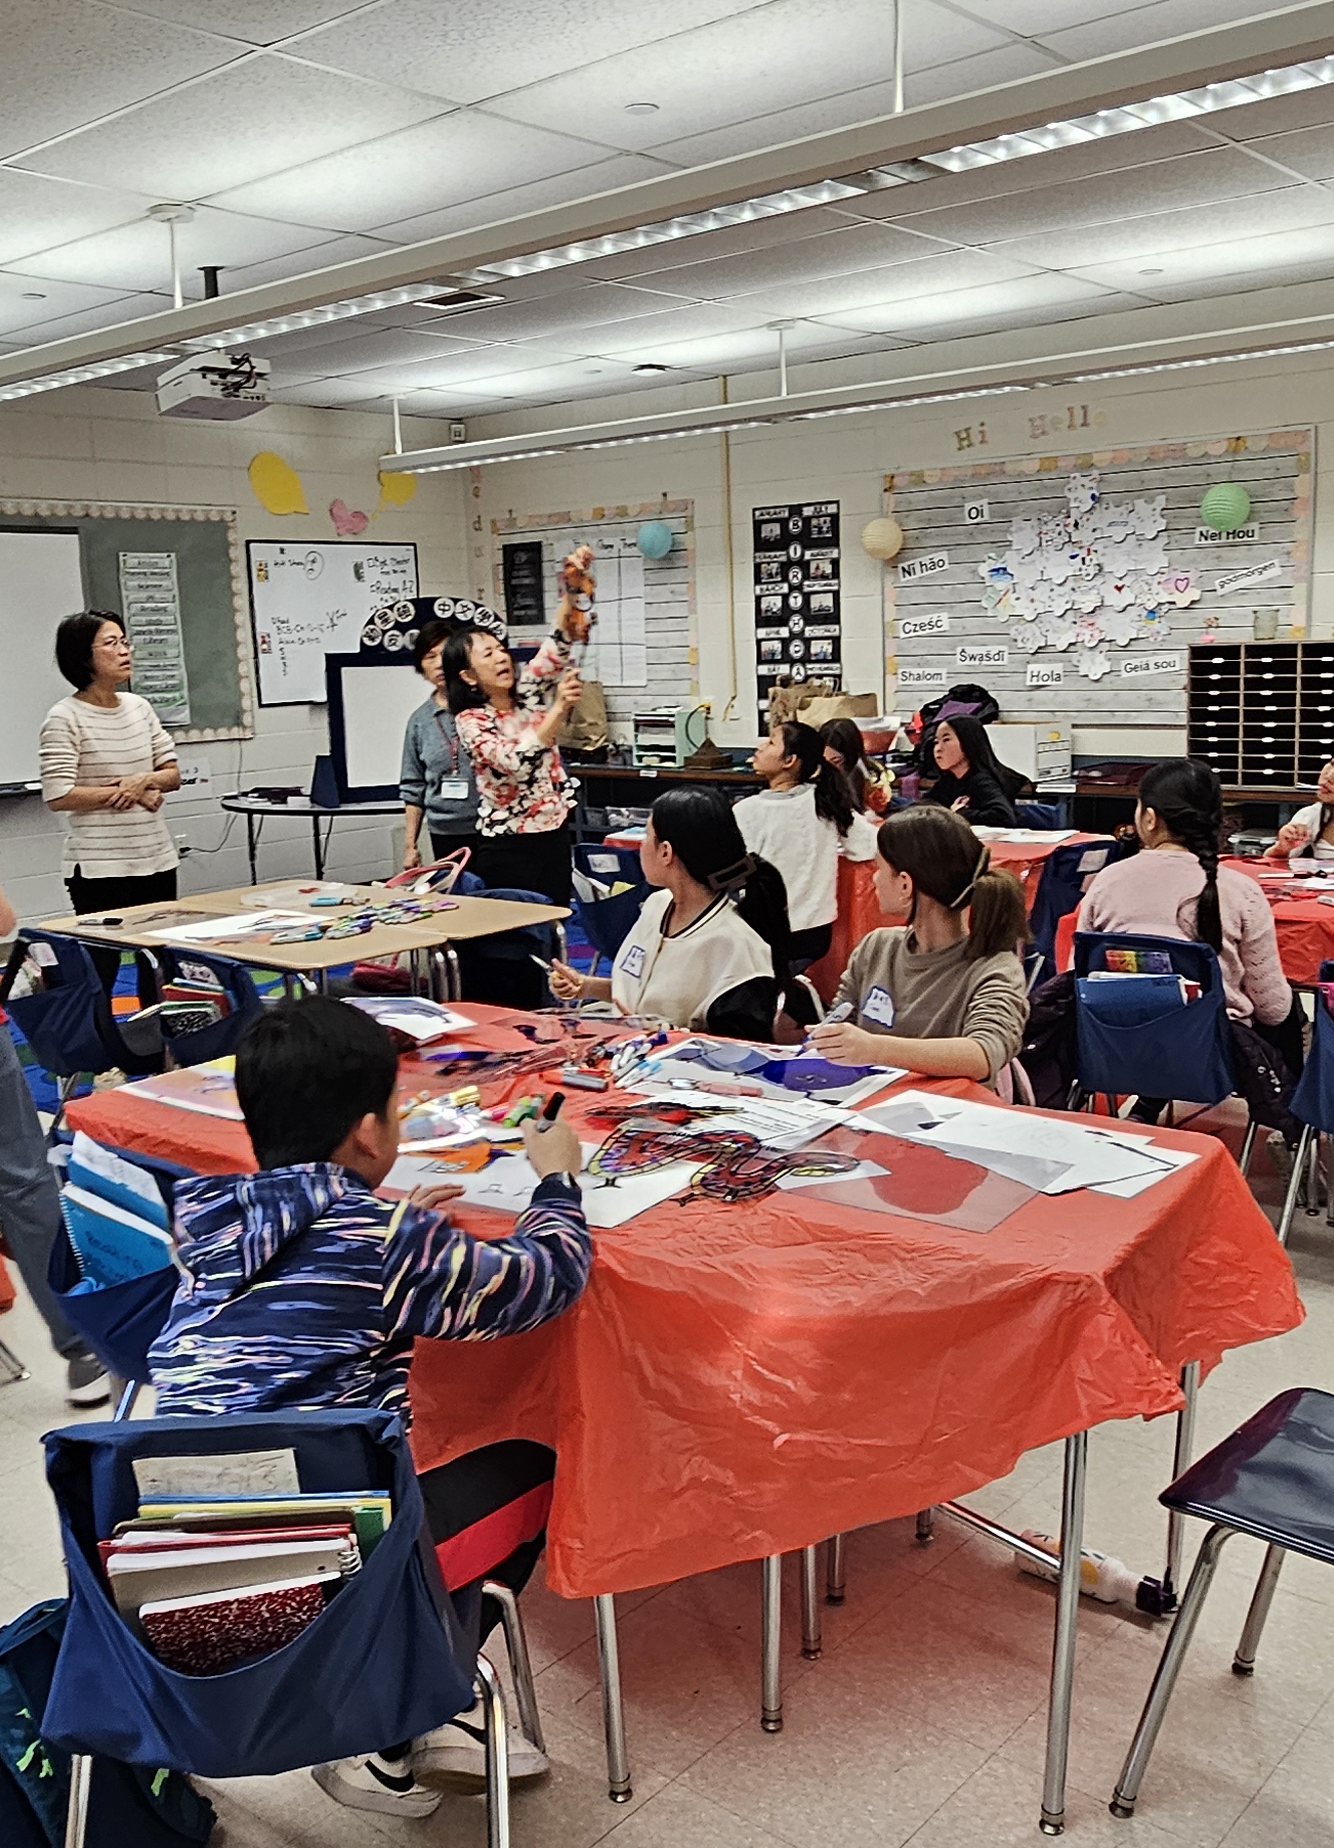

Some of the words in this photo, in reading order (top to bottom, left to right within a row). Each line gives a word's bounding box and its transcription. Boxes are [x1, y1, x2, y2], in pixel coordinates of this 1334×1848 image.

[954, 421, 988, 451] Hi
[1028, 404, 1107, 439] Hello
[968, 505, 985, 520] Oi
[1153, 658, 1177, 669] sou
[900, 670, 943, 682] Shalom
[1029, 670, 1062, 683] Hola
